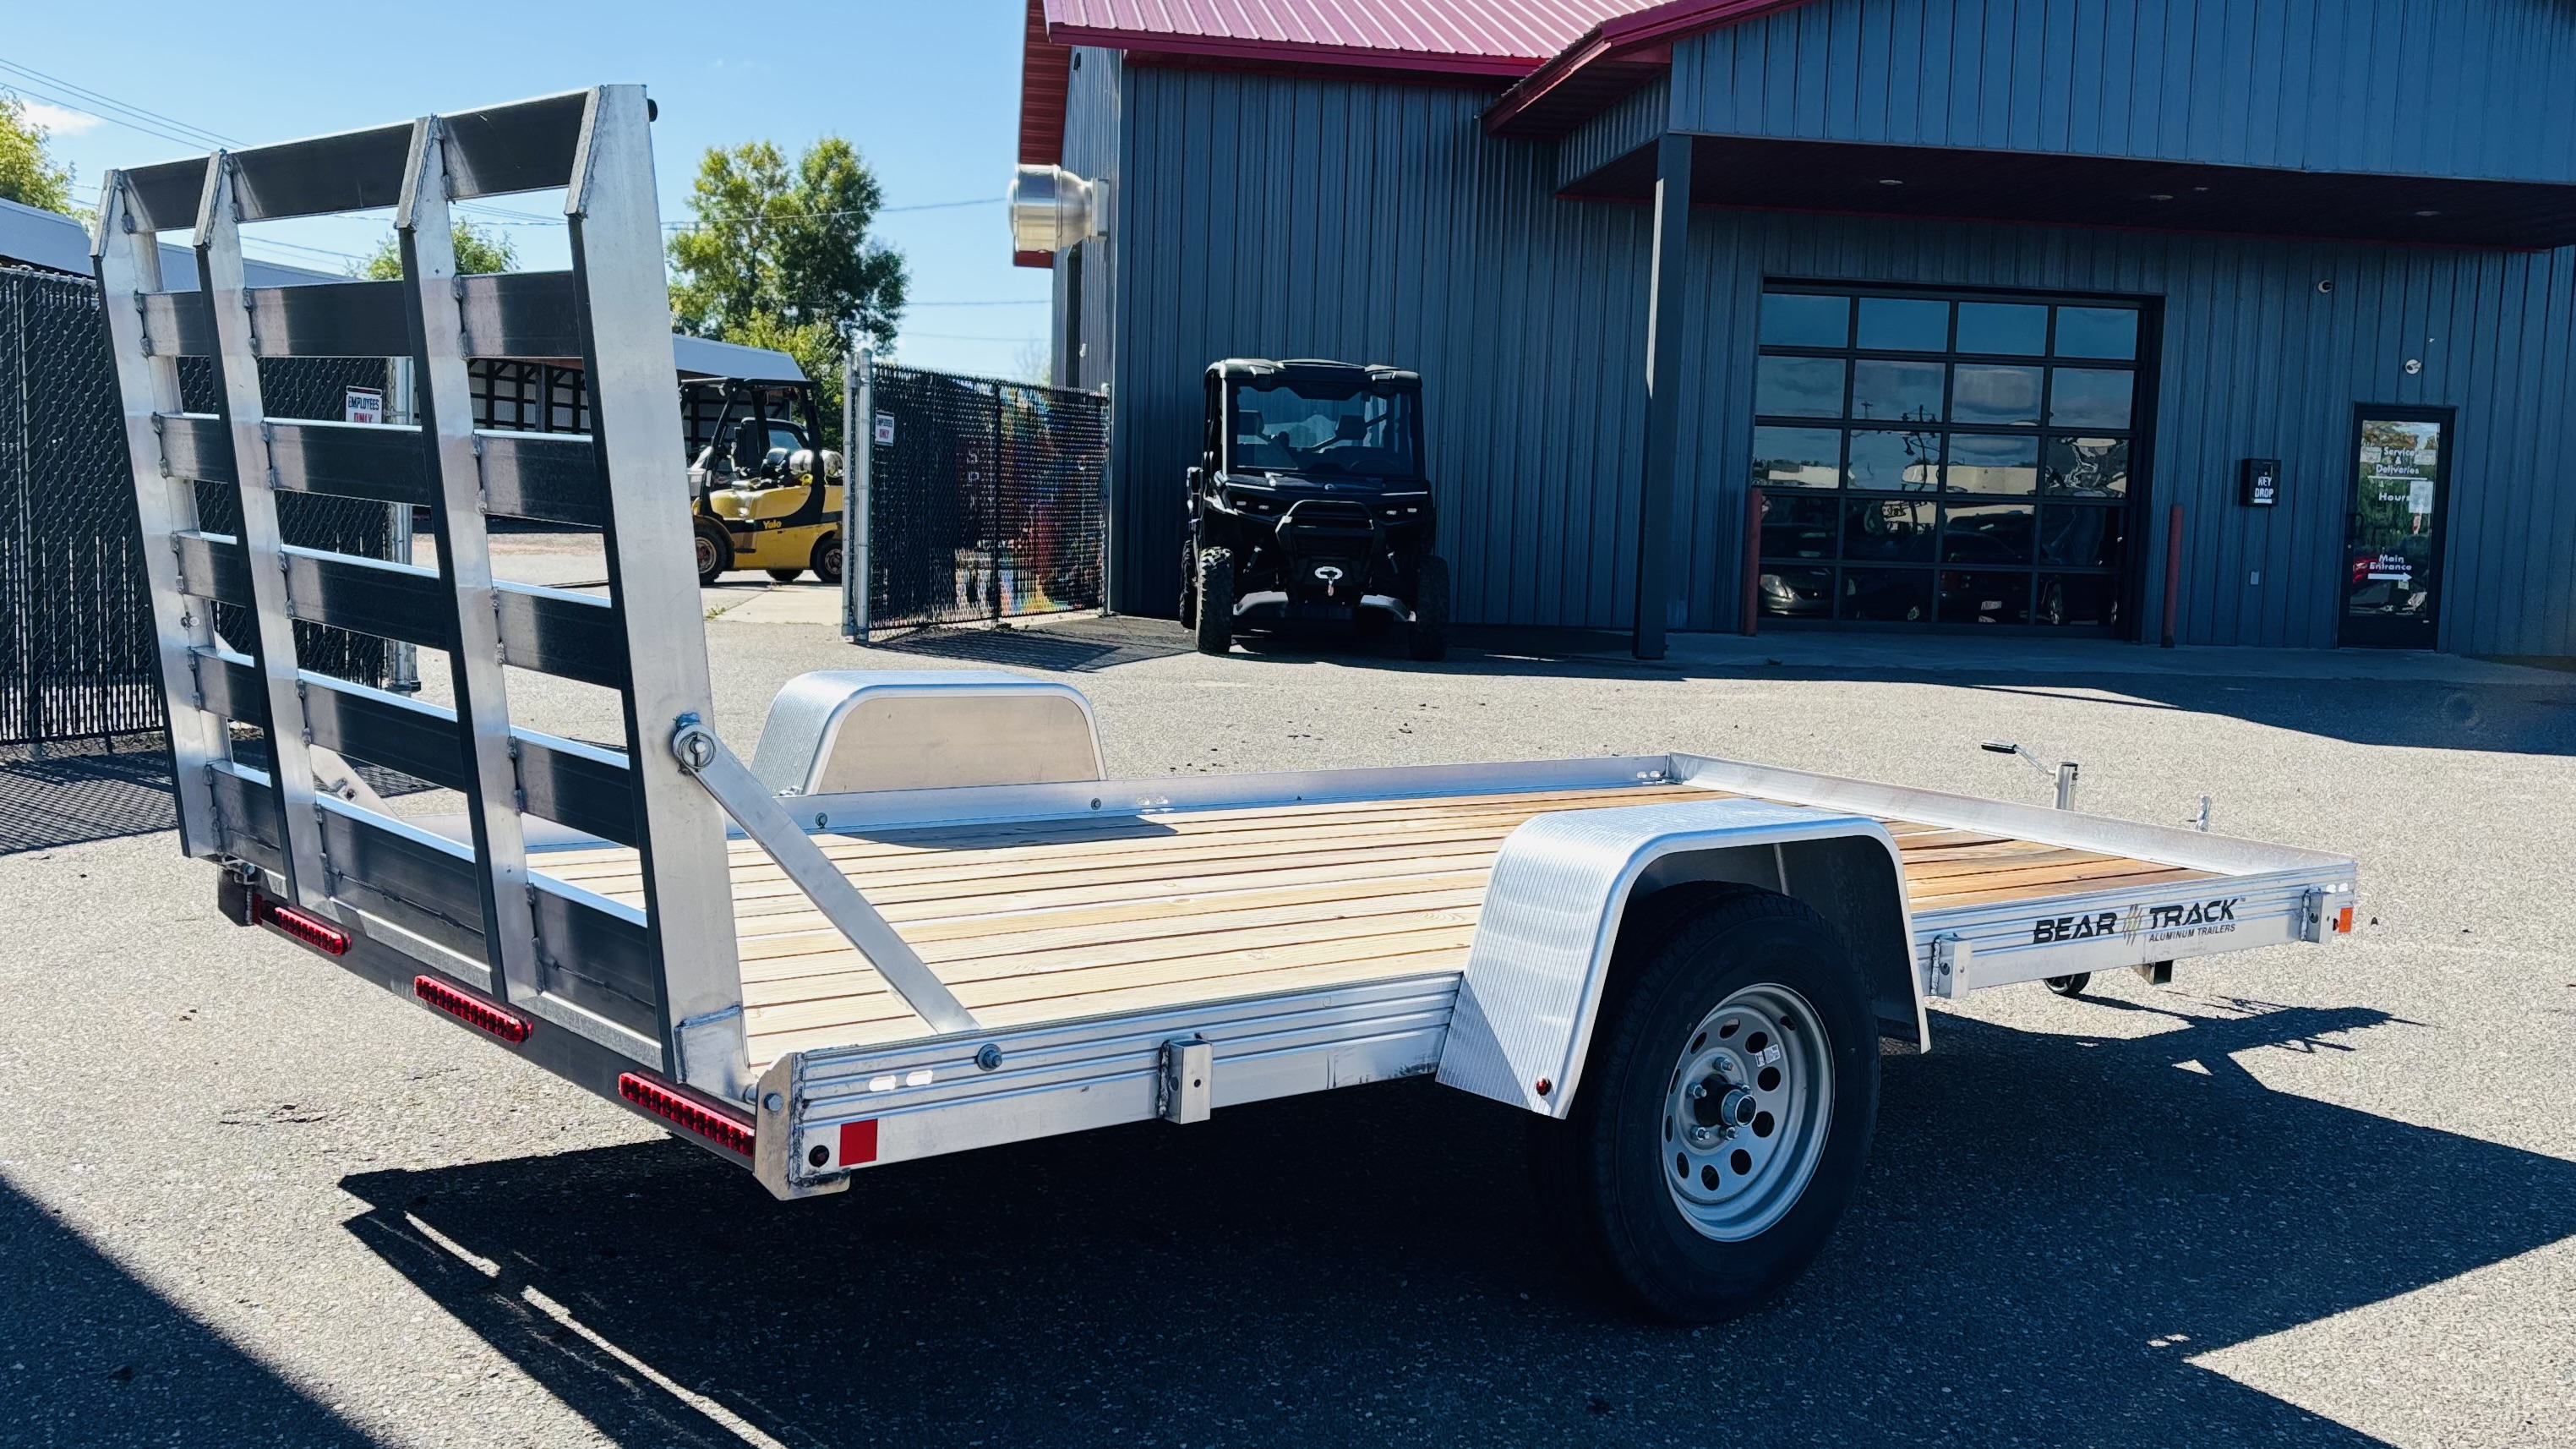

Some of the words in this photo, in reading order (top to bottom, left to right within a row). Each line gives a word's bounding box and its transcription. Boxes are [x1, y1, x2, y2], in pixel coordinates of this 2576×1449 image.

[348, 396, 379, 411] EMPLOYEES
[2376, 464, 2420, 474] Deliveries
[2257, 476, 2272, 487] KEY
[2254, 488, 2274, 498] DROP
[763, 519, 783, 530] Yale
[2379, 554, 2404, 564] Main
[2369, 562, 2412, 571] Entrance
[2033, 912, 2117, 944] BEAR
[2148, 898, 2239, 930] TRACK
[2148, 928, 2196, 943] ALUMINUM
[2197, 923, 2236, 937] TRAILERS
